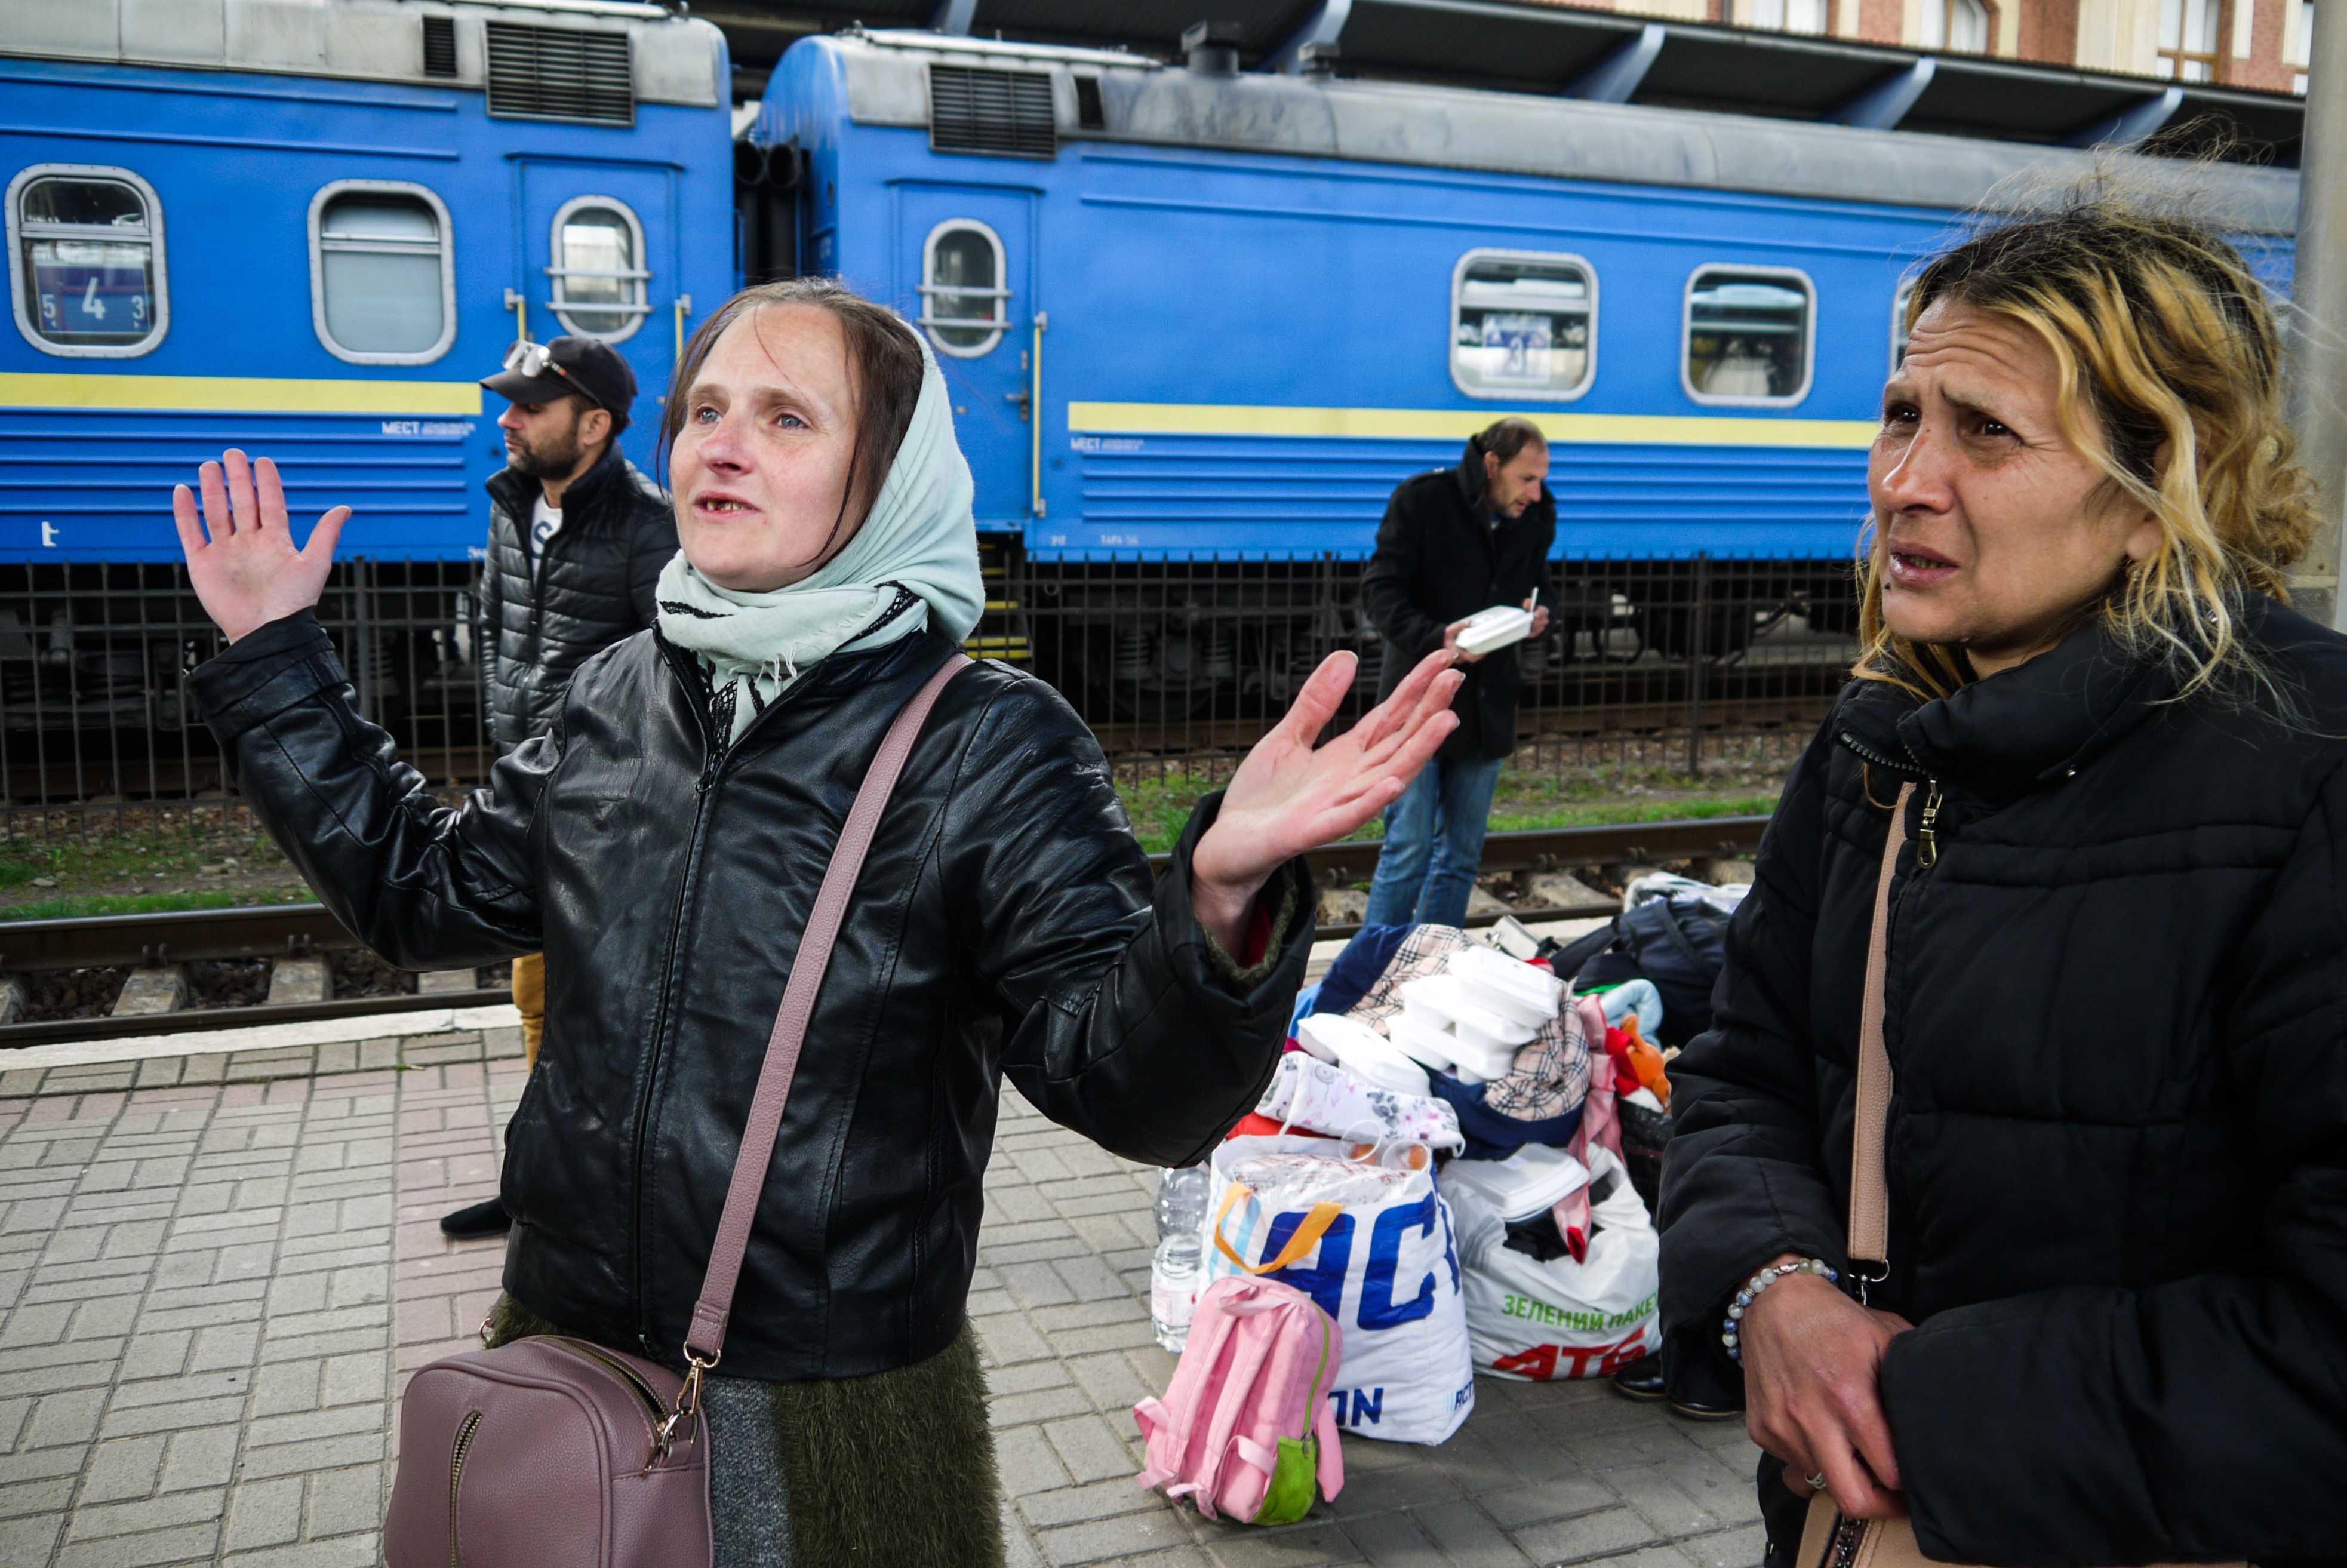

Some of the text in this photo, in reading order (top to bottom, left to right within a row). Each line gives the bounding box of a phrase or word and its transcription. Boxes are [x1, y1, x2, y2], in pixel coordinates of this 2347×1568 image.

[42, 277, 145, 320] 5 4 3
[1501, 1294, 1605, 1330] ЗЕЛЕНИЙ
